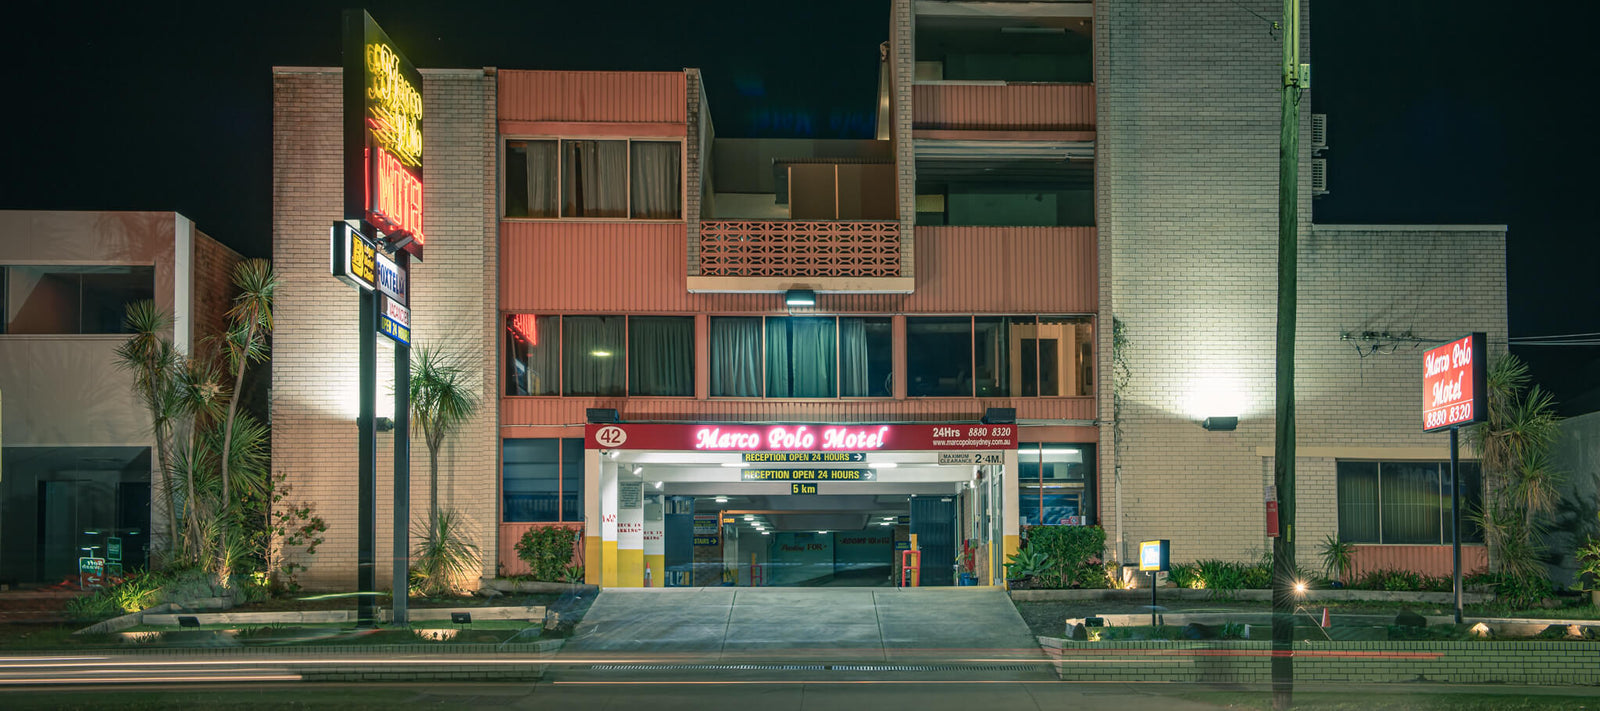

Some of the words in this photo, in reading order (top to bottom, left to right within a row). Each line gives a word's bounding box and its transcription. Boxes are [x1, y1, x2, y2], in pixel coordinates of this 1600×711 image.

[377, 148, 424, 245] MOTEL
[377, 261, 399, 295] FOXTEL
[382, 316, 392, 334] OPEN
[1425, 352, 1450, 379] Marco
[1452, 338, 1471, 369] Polo
[1432, 370, 1464, 407] Motel
[1426, 408, 1447, 428] 8880
[1449, 403, 1470, 423] 8320
[600, 429, 621, 443] 42
[695, 428, 760, 449] Marco
[768, 426, 814, 449] Polo
[822, 426, 888, 449] Motel
[933, 427, 960, 438] 24Hrs
[968, 427, 988, 437] 8880
[991, 427, 1011, 437] 8320
[932, 439, 1011, 447] www.marcopolosydney.com.au
[745, 453, 787, 461] RECEPTION
[789, 453, 809, 461] OPEN
[812, 453, 821, 461] 24
[824, 453, 850, 461] HOURS
[744, 470, 790, 479] RECEPTION
[792, 470, 815, 479] OPEN
[817, 470, 828, 479] 24
[831, 470, 860, 479] HOURS
[793, 484, 799, 494] 5
[801, 484, 816, 494] km
